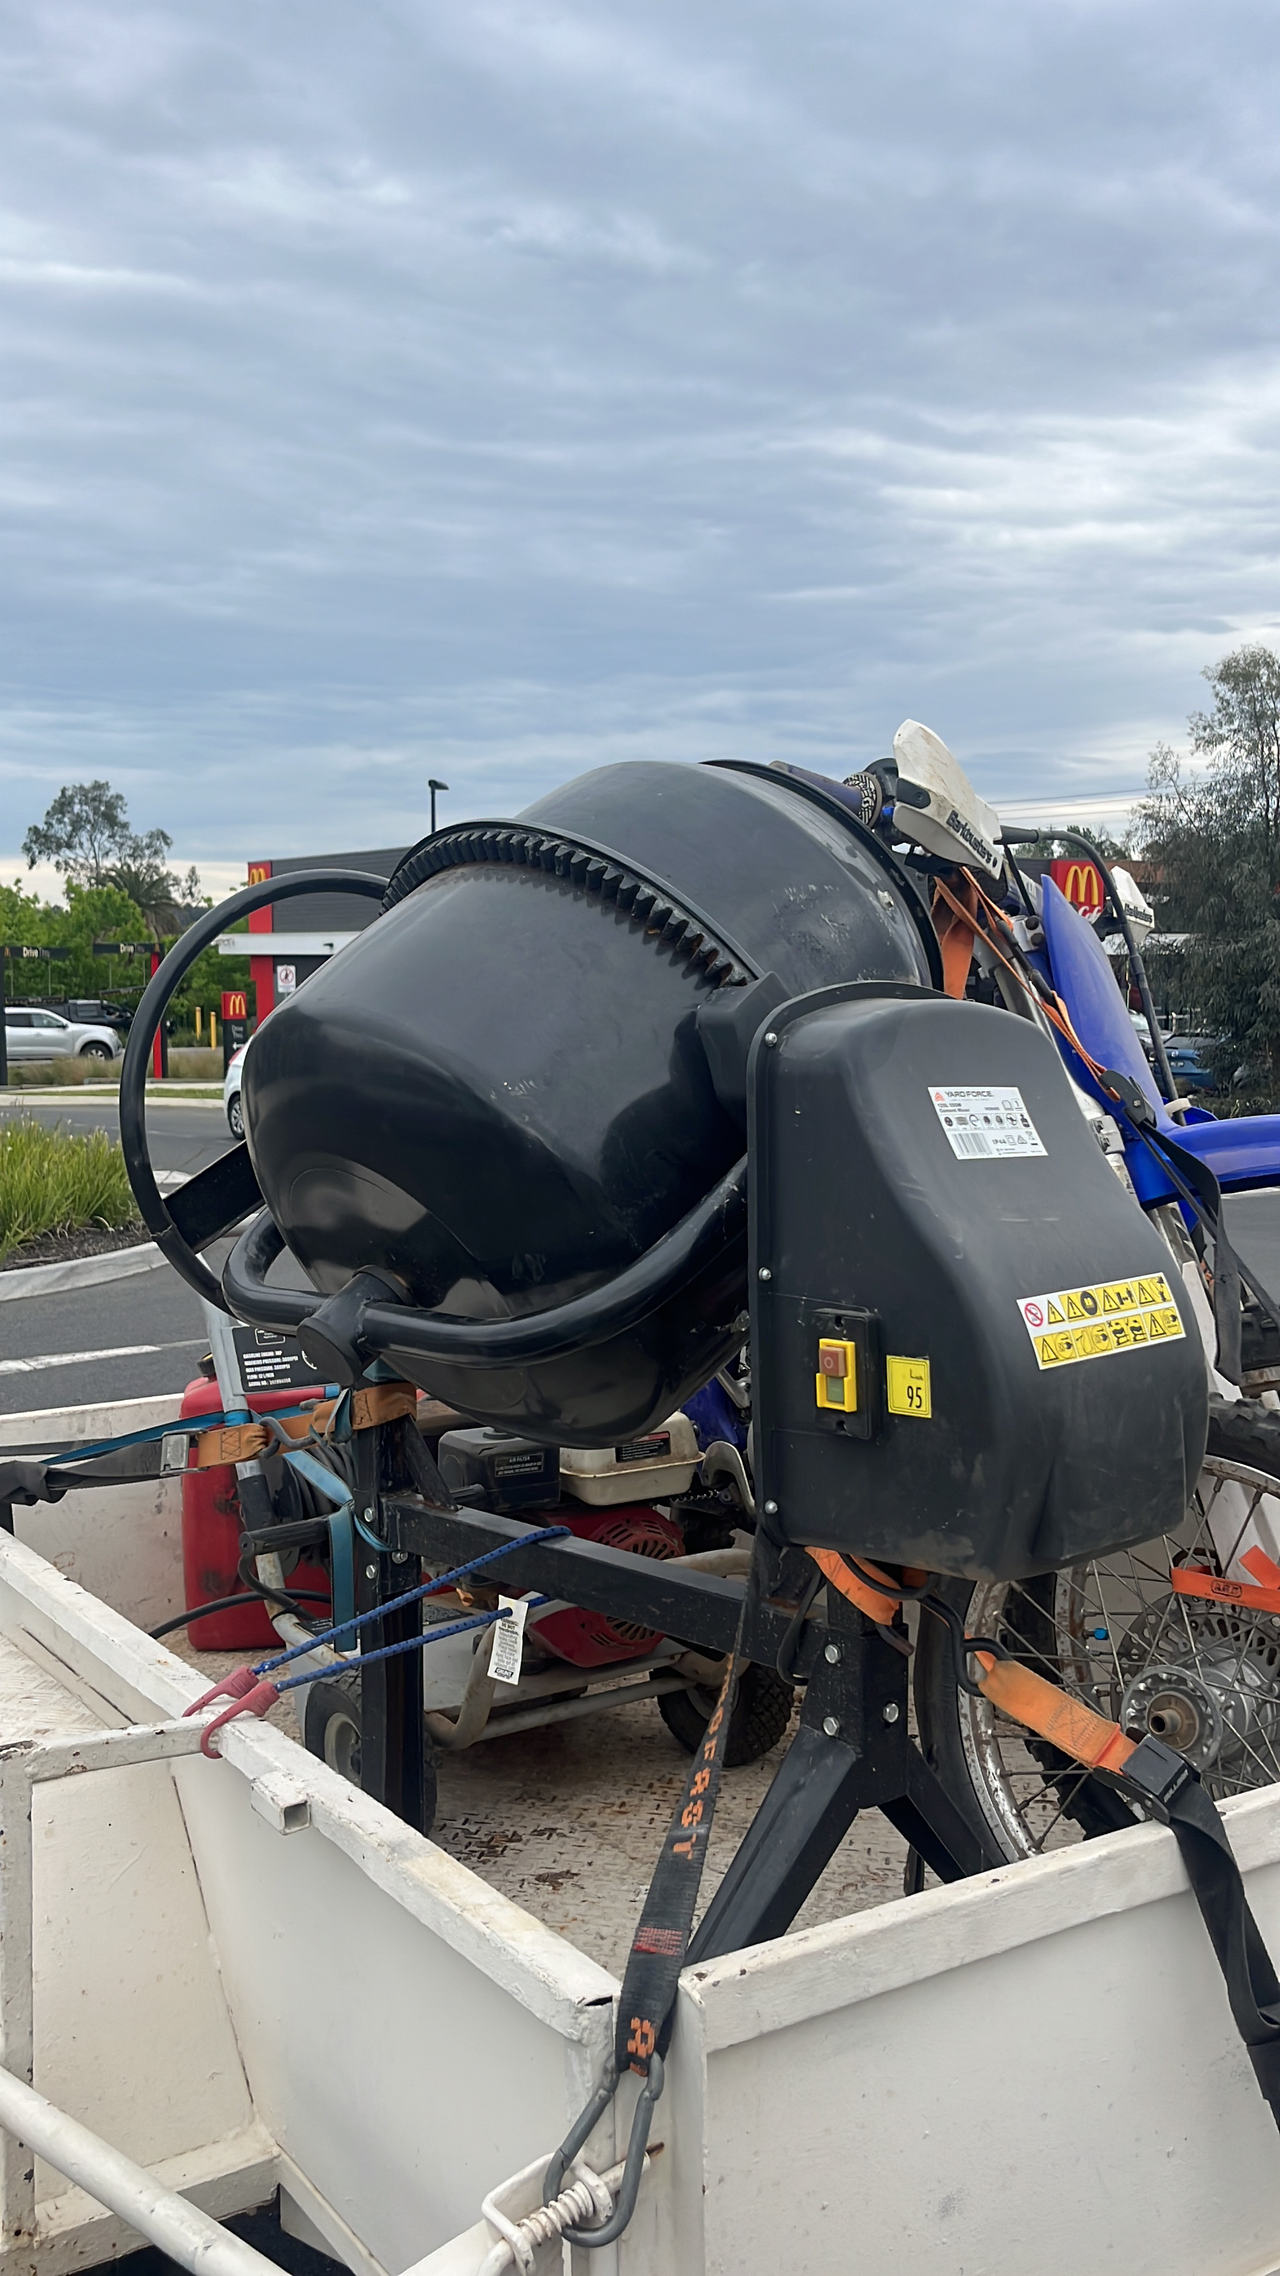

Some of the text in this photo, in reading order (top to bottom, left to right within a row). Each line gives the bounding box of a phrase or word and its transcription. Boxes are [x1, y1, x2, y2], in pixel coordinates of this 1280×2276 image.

[946, 809, 993, 864] Barkbusters
[22, 946, 39, 958] Drive
[120, 943, 135, 952] Drive
[906, 1385, 923, 1409] 95
